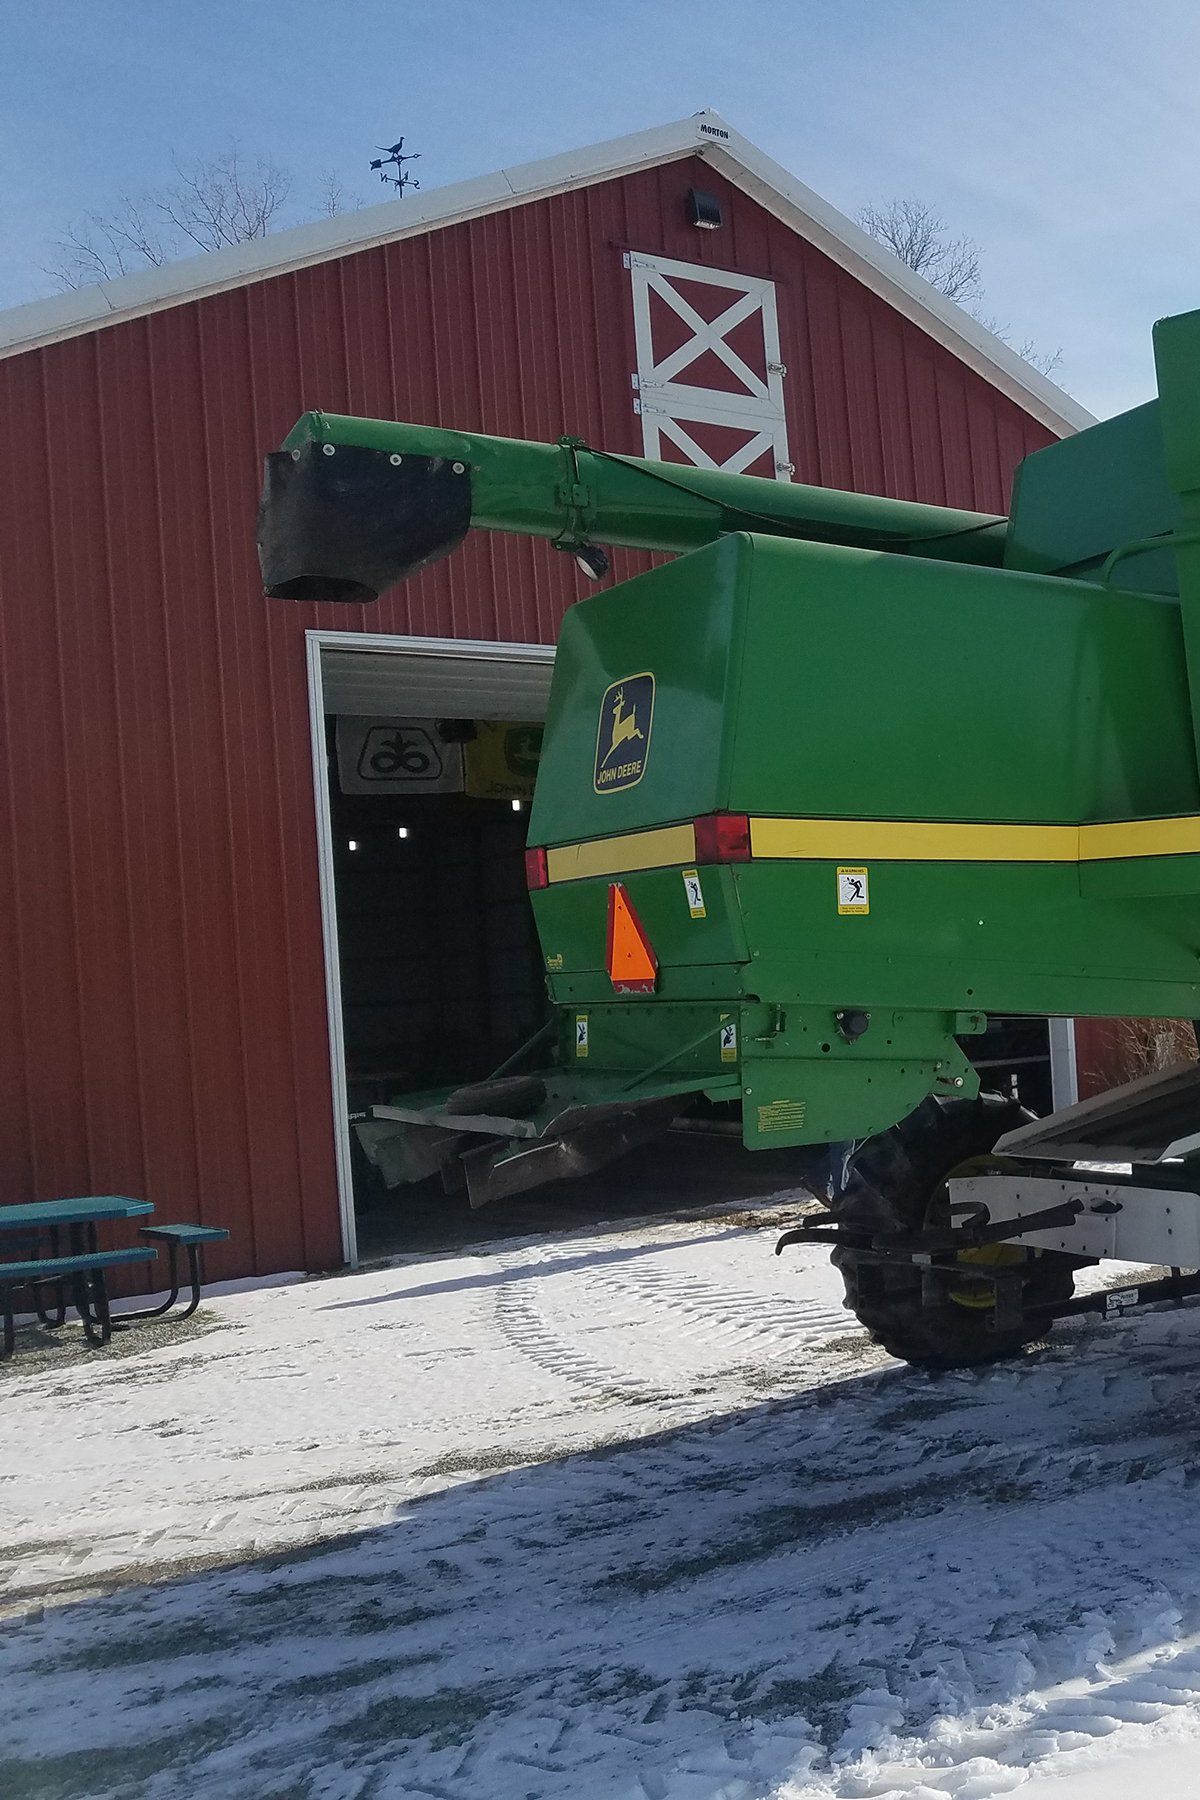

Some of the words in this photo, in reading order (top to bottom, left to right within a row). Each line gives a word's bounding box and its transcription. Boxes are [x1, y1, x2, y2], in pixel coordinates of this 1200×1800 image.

[700, 124, 729, 139] MORTON
[597, 768, 618, 785] JOHN
[618, 760, 642, 779] DEERE
